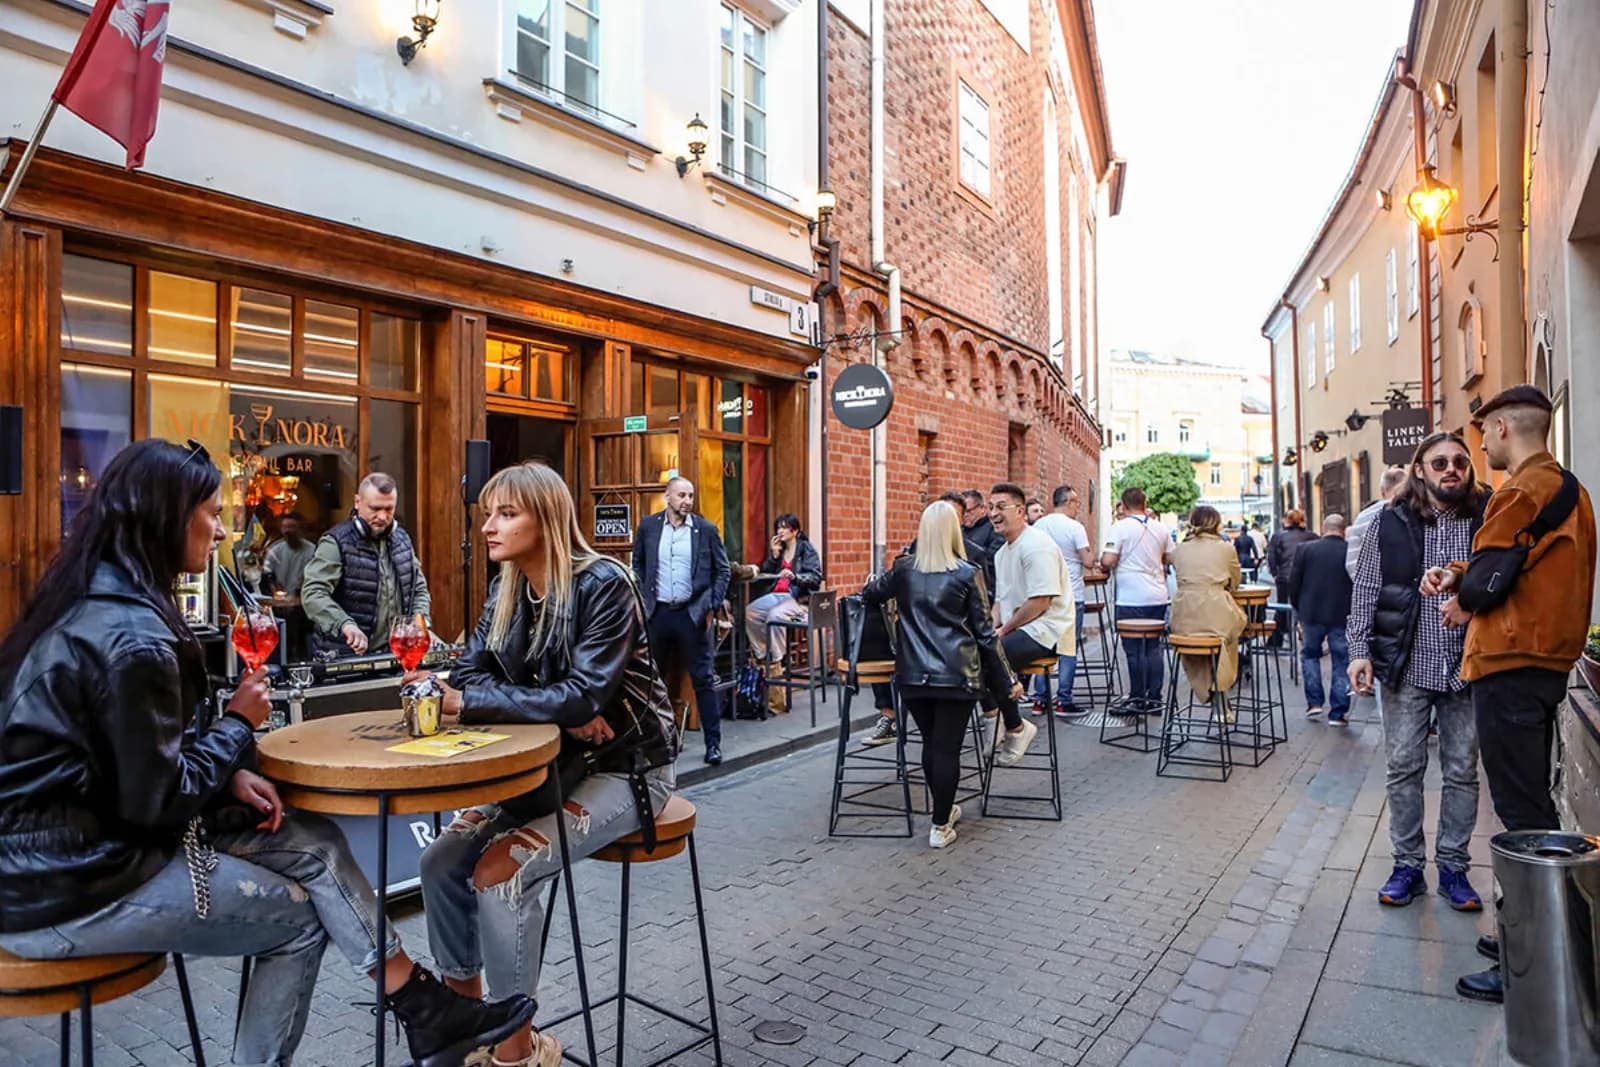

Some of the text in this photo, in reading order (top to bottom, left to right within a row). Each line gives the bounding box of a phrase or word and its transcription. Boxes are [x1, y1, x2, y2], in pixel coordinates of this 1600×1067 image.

[797, 306, 804, 330] 3
[276, 418, 345, 449] NORA
[1387, 425, 1424, 437] LINEN
[286, 457, 313, 473] BAR
[596, 523, 627, 534] OPEN
